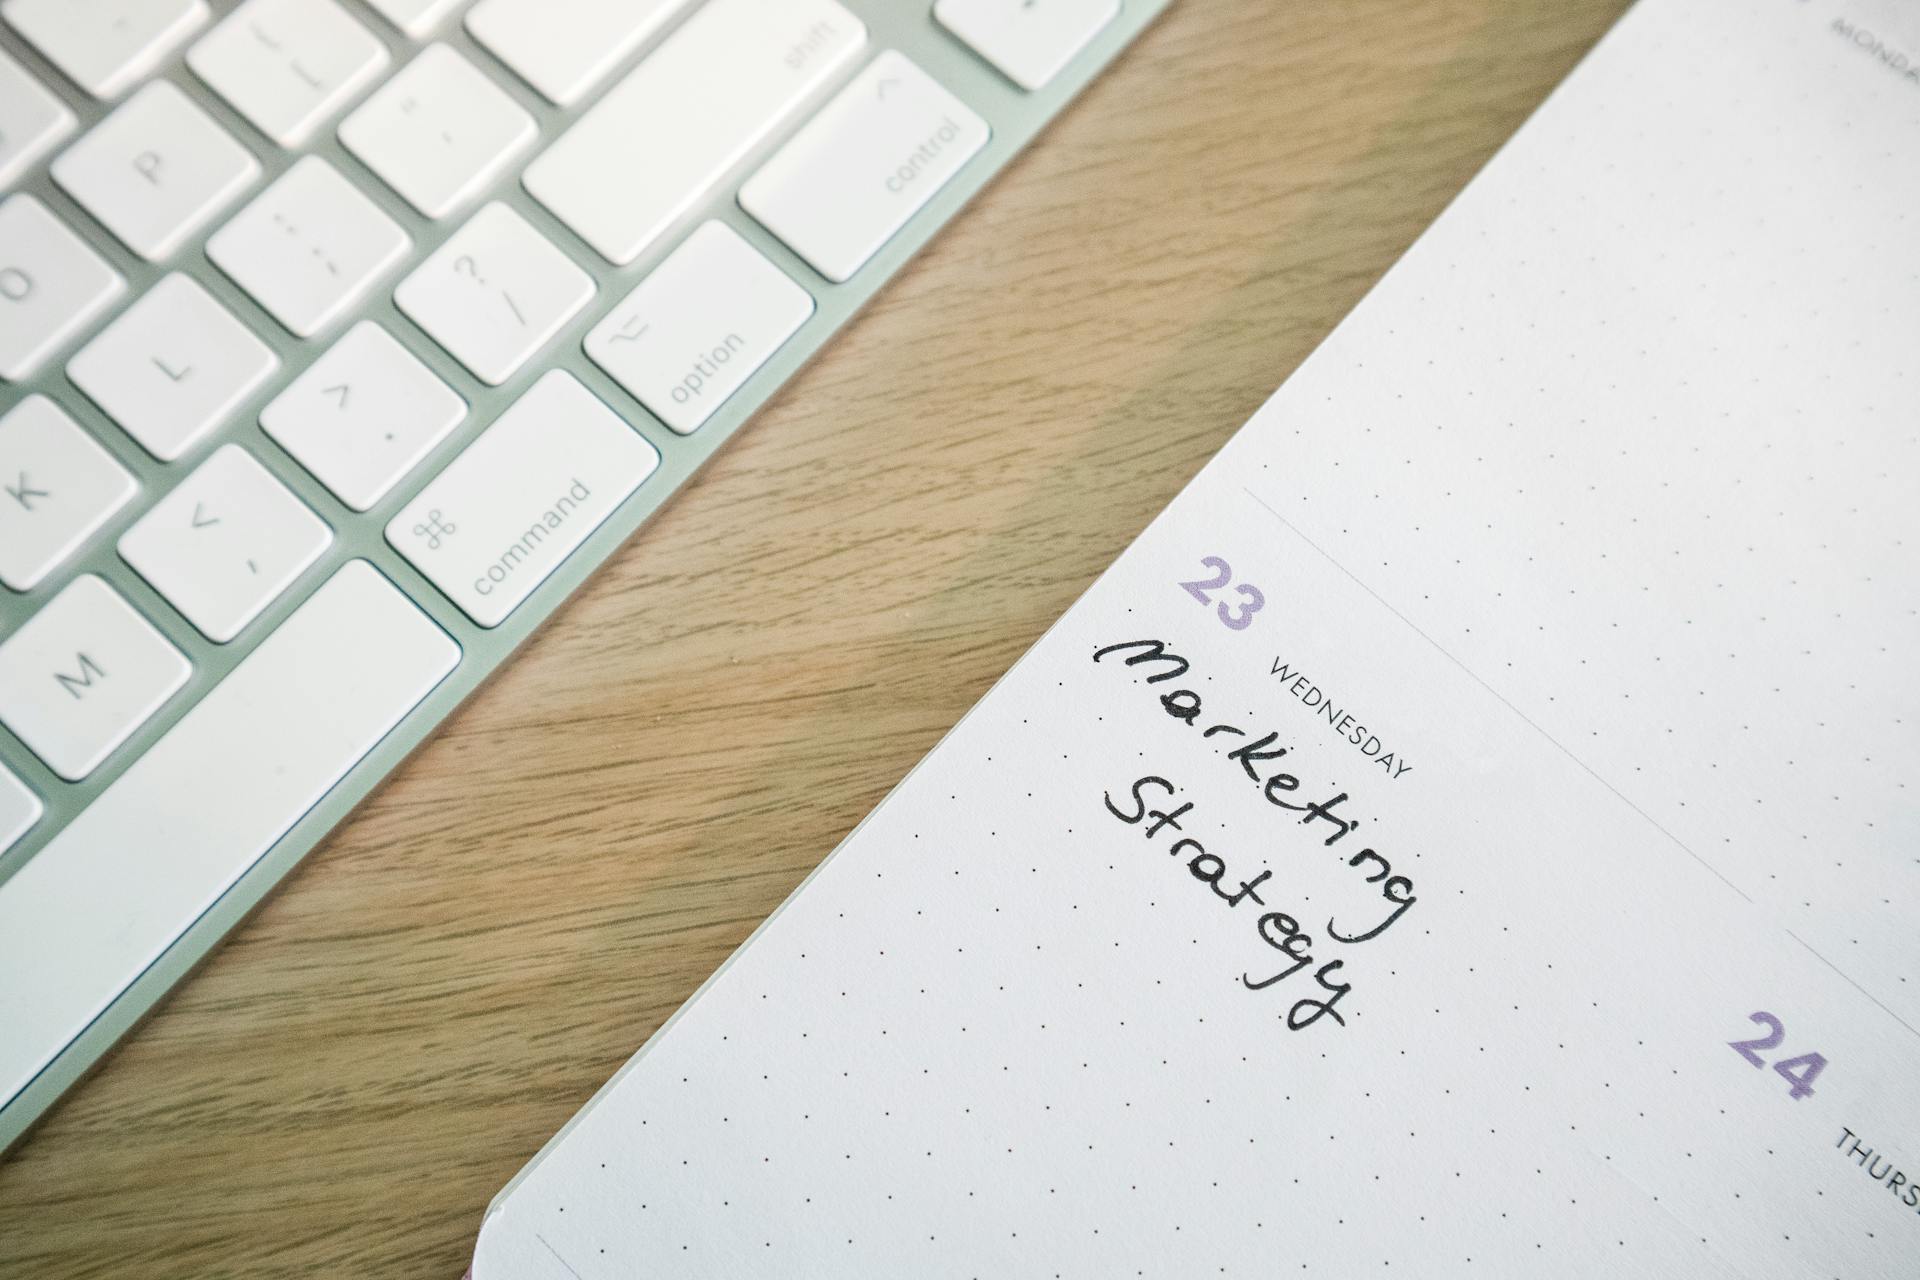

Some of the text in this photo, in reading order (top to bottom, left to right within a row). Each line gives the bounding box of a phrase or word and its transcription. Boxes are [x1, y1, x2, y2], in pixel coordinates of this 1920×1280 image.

[783, 18, 838, 70] shift
[132, 151, 163, 186] P
[884, 115, 961, 194] control
[151, 357, 192, 383] L
[671, 330, 746, 405] option
[4, 471, 51, 511] K
[473, 477, 592, 597] command
[1178, 556, 1265, 631] 23
[53, 651, 106, 699] M
[1270, 655, 1413, 780] WEDNESDAY
[1104, 776, 1352, 1031] Strategy
[1727, 1011, 1828, 1101] 24
[1835, 1126, 1920, 1217] THURS
